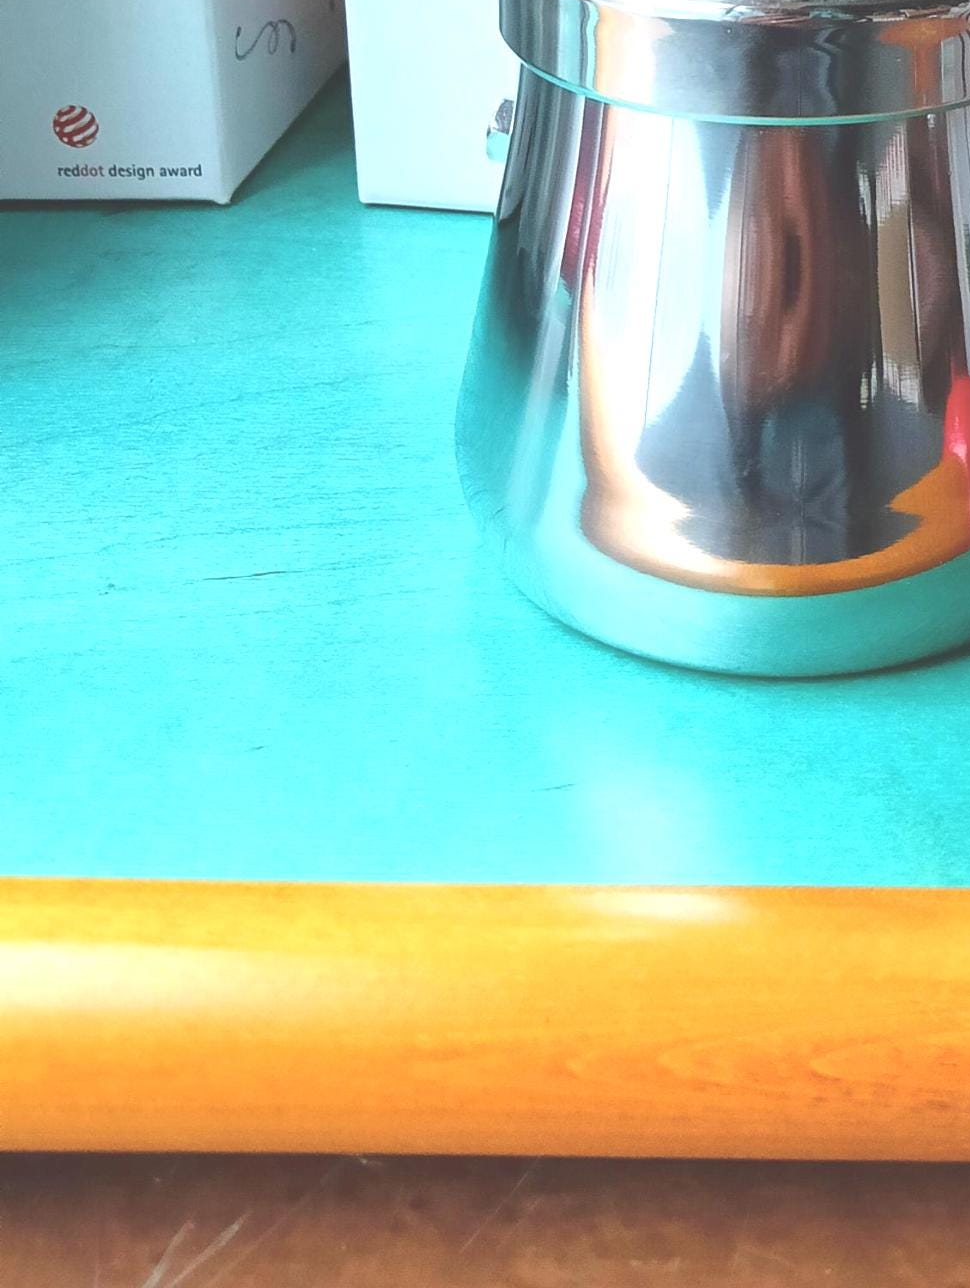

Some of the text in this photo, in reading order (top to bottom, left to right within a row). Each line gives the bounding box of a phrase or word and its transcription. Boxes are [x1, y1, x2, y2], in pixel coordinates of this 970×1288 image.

[57, 163, 202, 181] reddot design award
